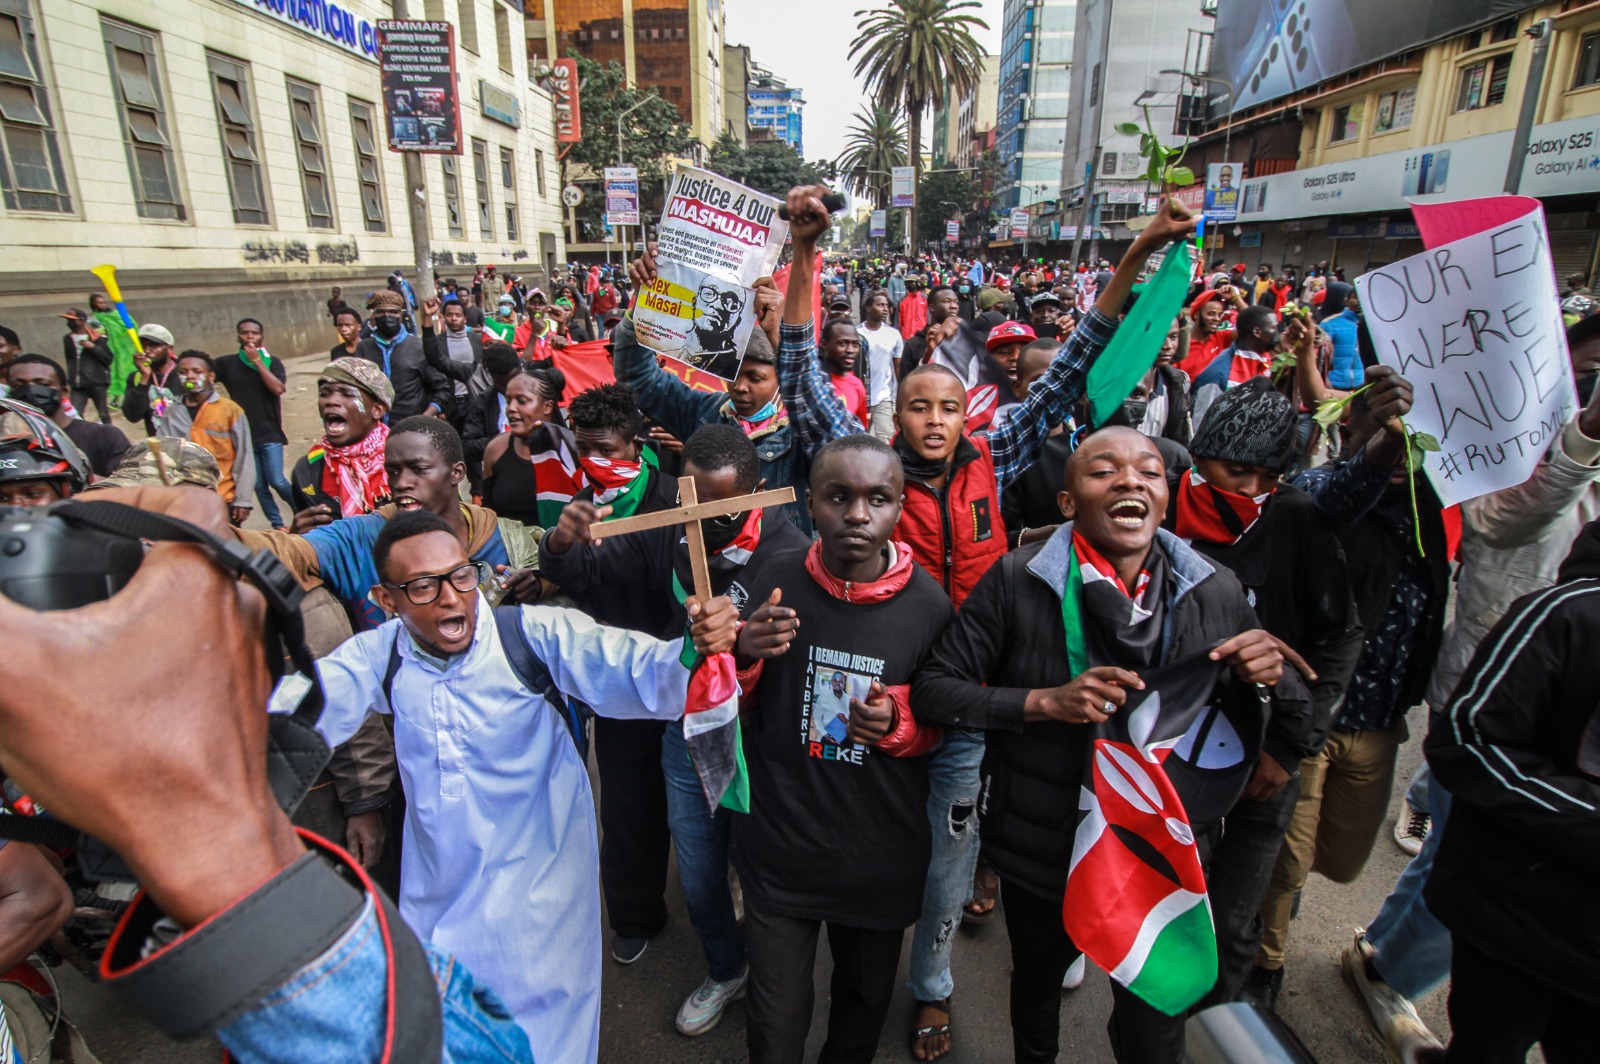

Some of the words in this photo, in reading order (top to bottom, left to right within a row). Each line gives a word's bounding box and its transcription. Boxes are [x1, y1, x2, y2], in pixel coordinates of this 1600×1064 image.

[378, 20, 448, 32] GEMMARZ
[381, 45, 420, 53] SUPERIOR
[390, 54, 418, 62] OPPOSITE
[429, 65, 450, 73] AVENUE
[554, 65, 572, 134] naivas
[1568, 132, 1593, 149] S25
[1535, 160, 1575, 175] Galaxy
[1575, 157, 1588, 170] AI
[1303, 176, 1326, 188] Galaxy
[1326, 172, 1338, 185] S25
[1338, 171, 1356, 183] Ultra
[675, 173, 731, 209] Justice
[732, 193, 747, 216] 4
[746, 199, 776, 226] Our
[1311, 191, 1329, 201] Galaxy
[668, 198, 766, 247] MASHUJAA
[684, 231, 709, 244] prosecute
[680, 239, 715, 255] compensation
[715, 248, 723, 257] for
[719, 259, 739, 271] several
[1368, 249, 1471, 322] OUR
[644, 291, 683, 317] Masai
[1391, 301, 1536, 375] WERE
[808, 645, 814, 660] I
[815, 646, 851, 668] DEMAND
[851, 653, 885, 676] JUSTICE
[800, 661, 814, 745] ALBERT
